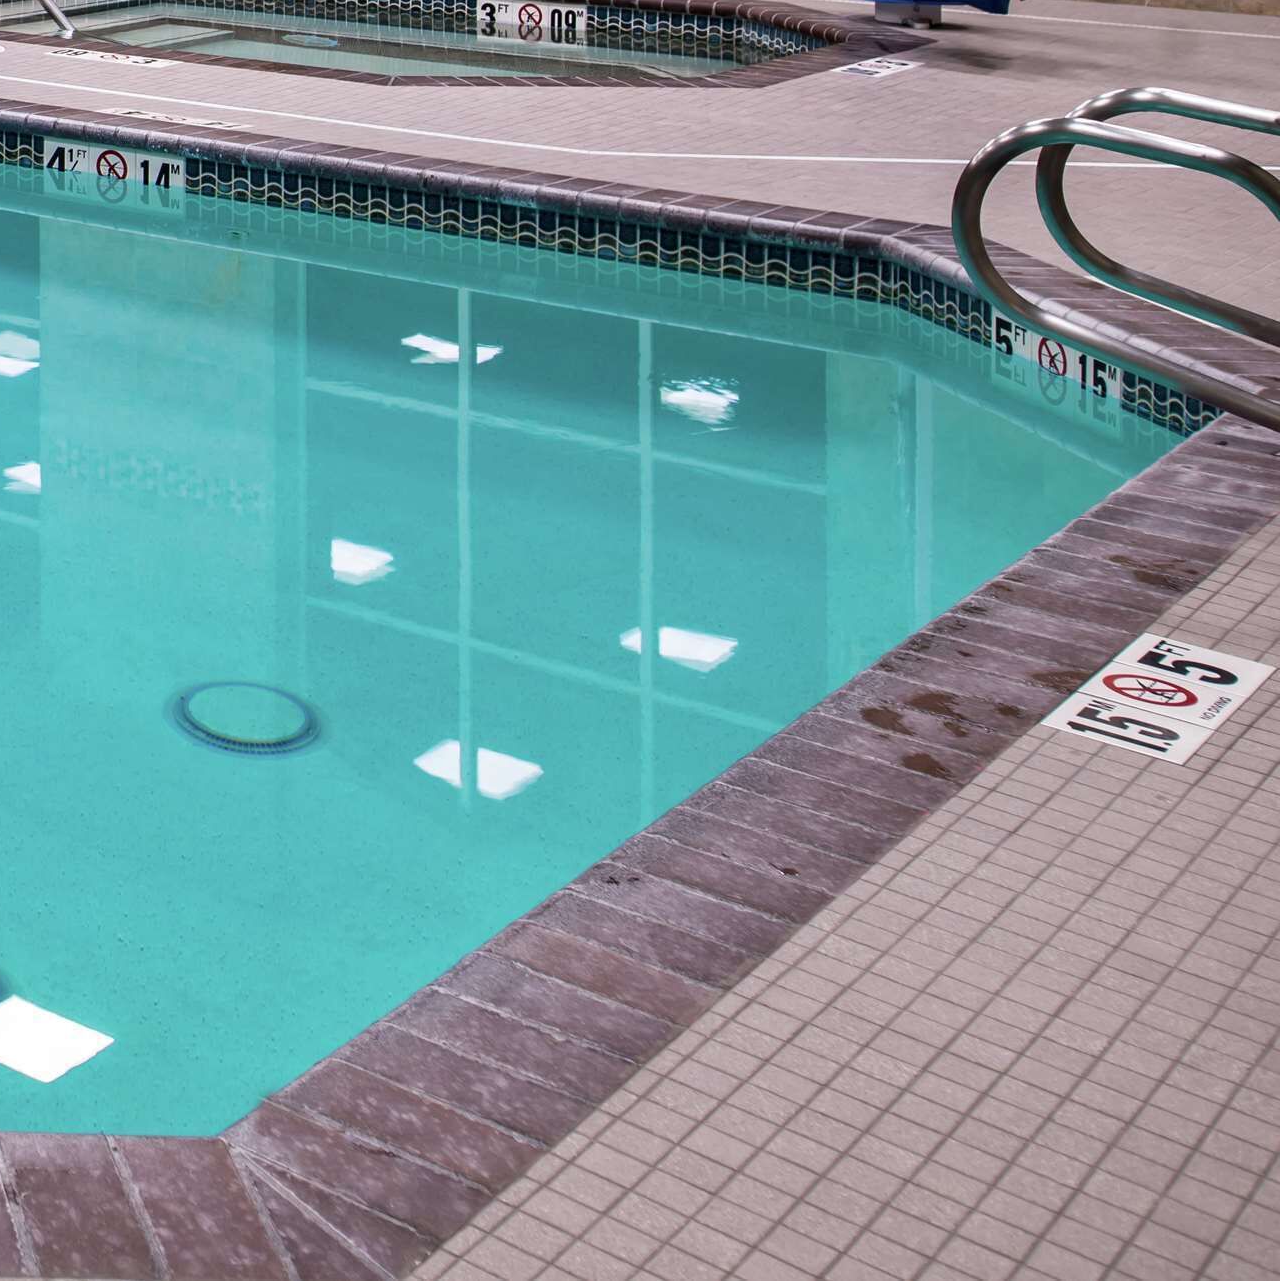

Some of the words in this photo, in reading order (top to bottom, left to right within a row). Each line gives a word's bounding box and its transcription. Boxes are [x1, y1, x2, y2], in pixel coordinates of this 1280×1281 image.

[498, 4, 509, 13] FT
[46, 146, 66, 172] 4
[171, 164, 180, 175] M
[995, 317, 1013, 355] 5
[1015, 326, 1027, 345] FT
[1108, 365, 1117, 381] M
[1153, 639, 1194, 657] FT
[1137, 649, 1239, 686] 5
[1088, 699, 1116, 712] M
